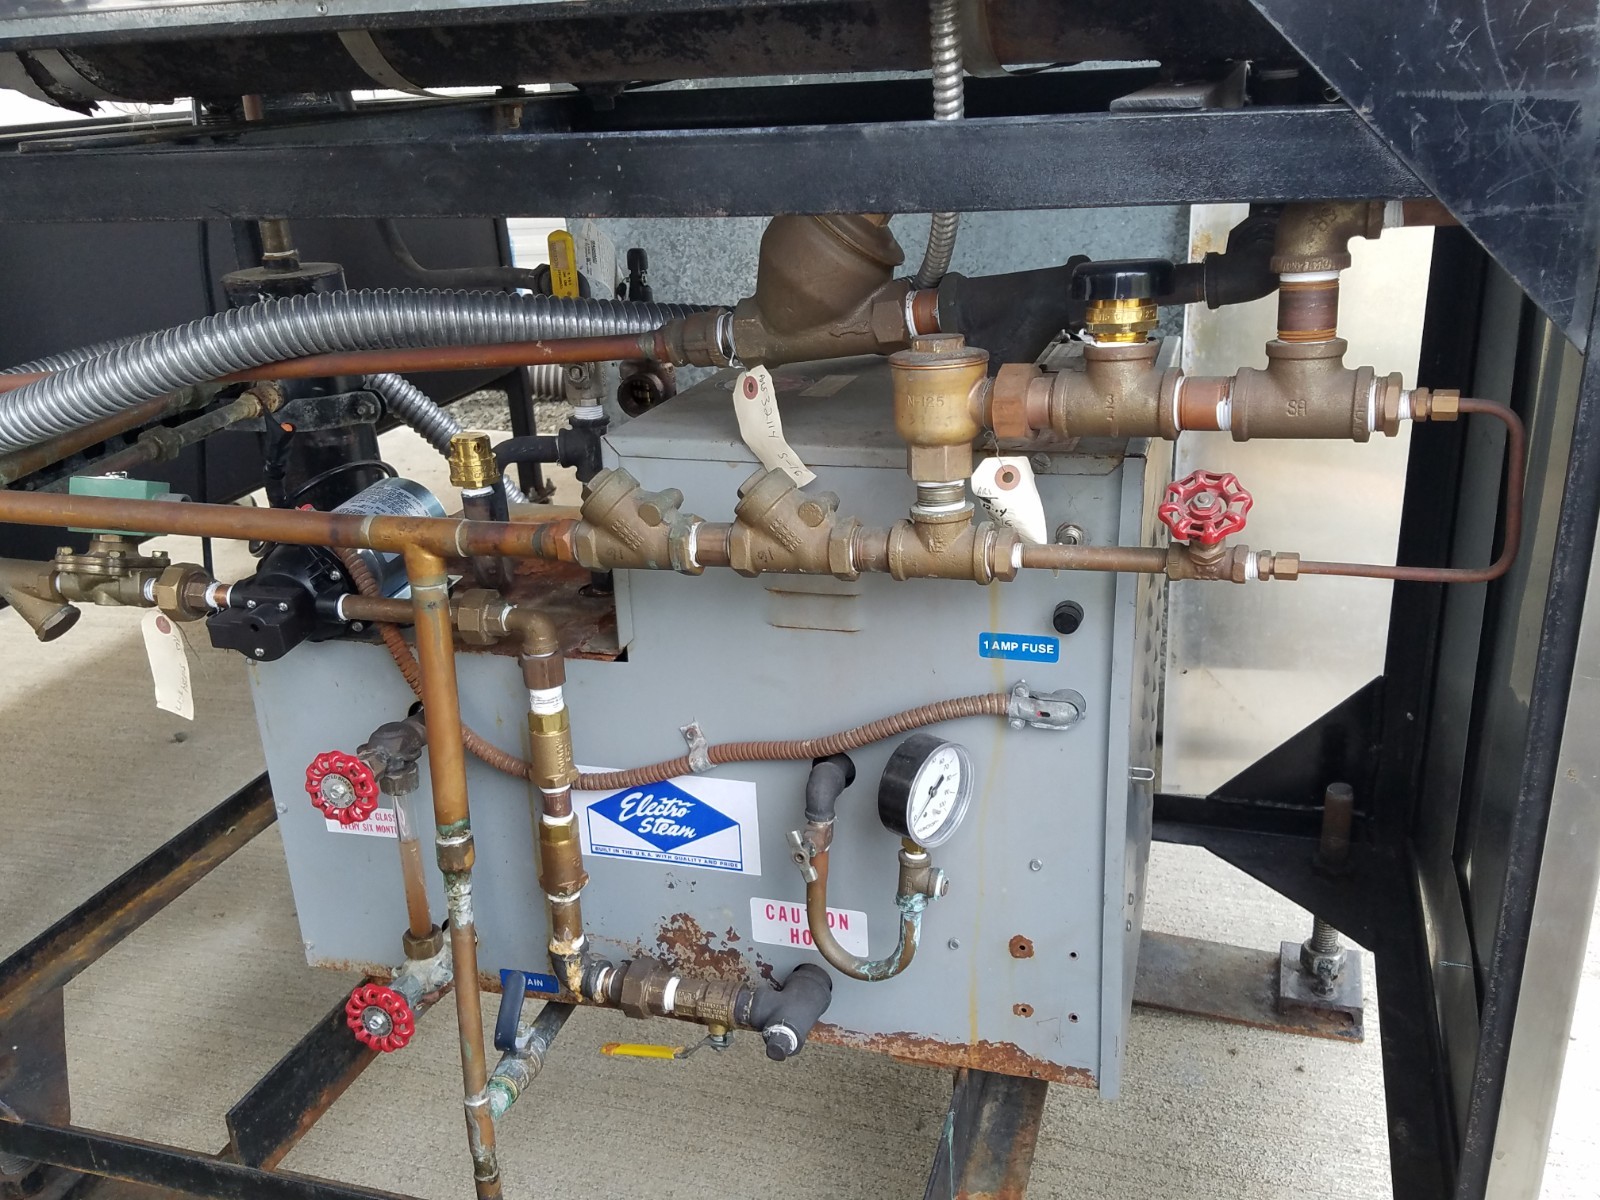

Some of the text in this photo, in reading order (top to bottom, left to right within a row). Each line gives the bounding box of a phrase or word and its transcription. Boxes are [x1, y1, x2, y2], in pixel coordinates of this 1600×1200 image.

[907, 393, 945, 408] N-125
[983, 640, 1055, 654] 1 AMP FUSE
[618, 791, 696, 823] Electro
[362, 823, 374, 832] SIX
[637, 817, 697, 839] Steam
[674, 855, 702, 864] QUALITY
[704, 858, 718, 866] AND
[719, 861, 739, 869] PRIDE
[765, 904, 849, 931] CAUON
[790, 928, 814, 946] HO
[527, 978, 544, 987] AIN
